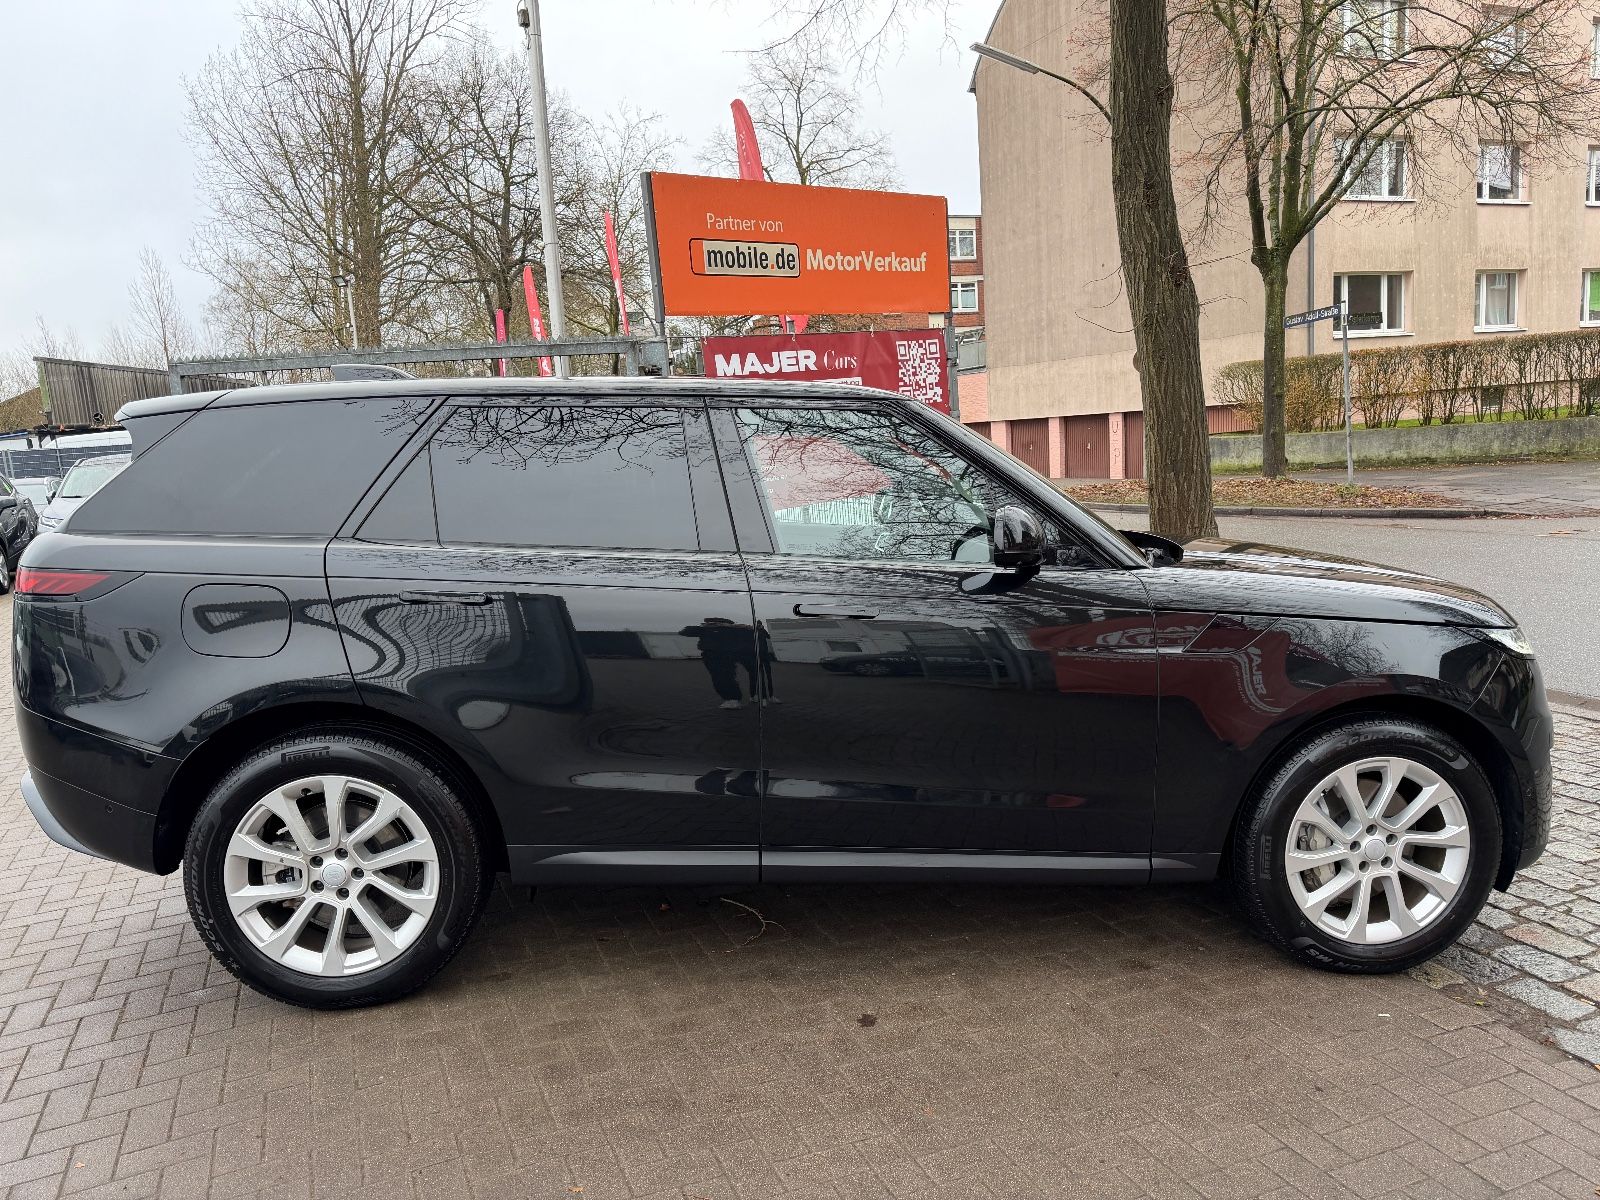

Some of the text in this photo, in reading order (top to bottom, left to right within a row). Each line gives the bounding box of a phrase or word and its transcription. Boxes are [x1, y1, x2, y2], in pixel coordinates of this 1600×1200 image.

[706, 212, 784, 233] Partner von
[707, 245, 927, 273] mobile.de MotorVerkauf
[714, 350, 857, 377] MAJER Cars
